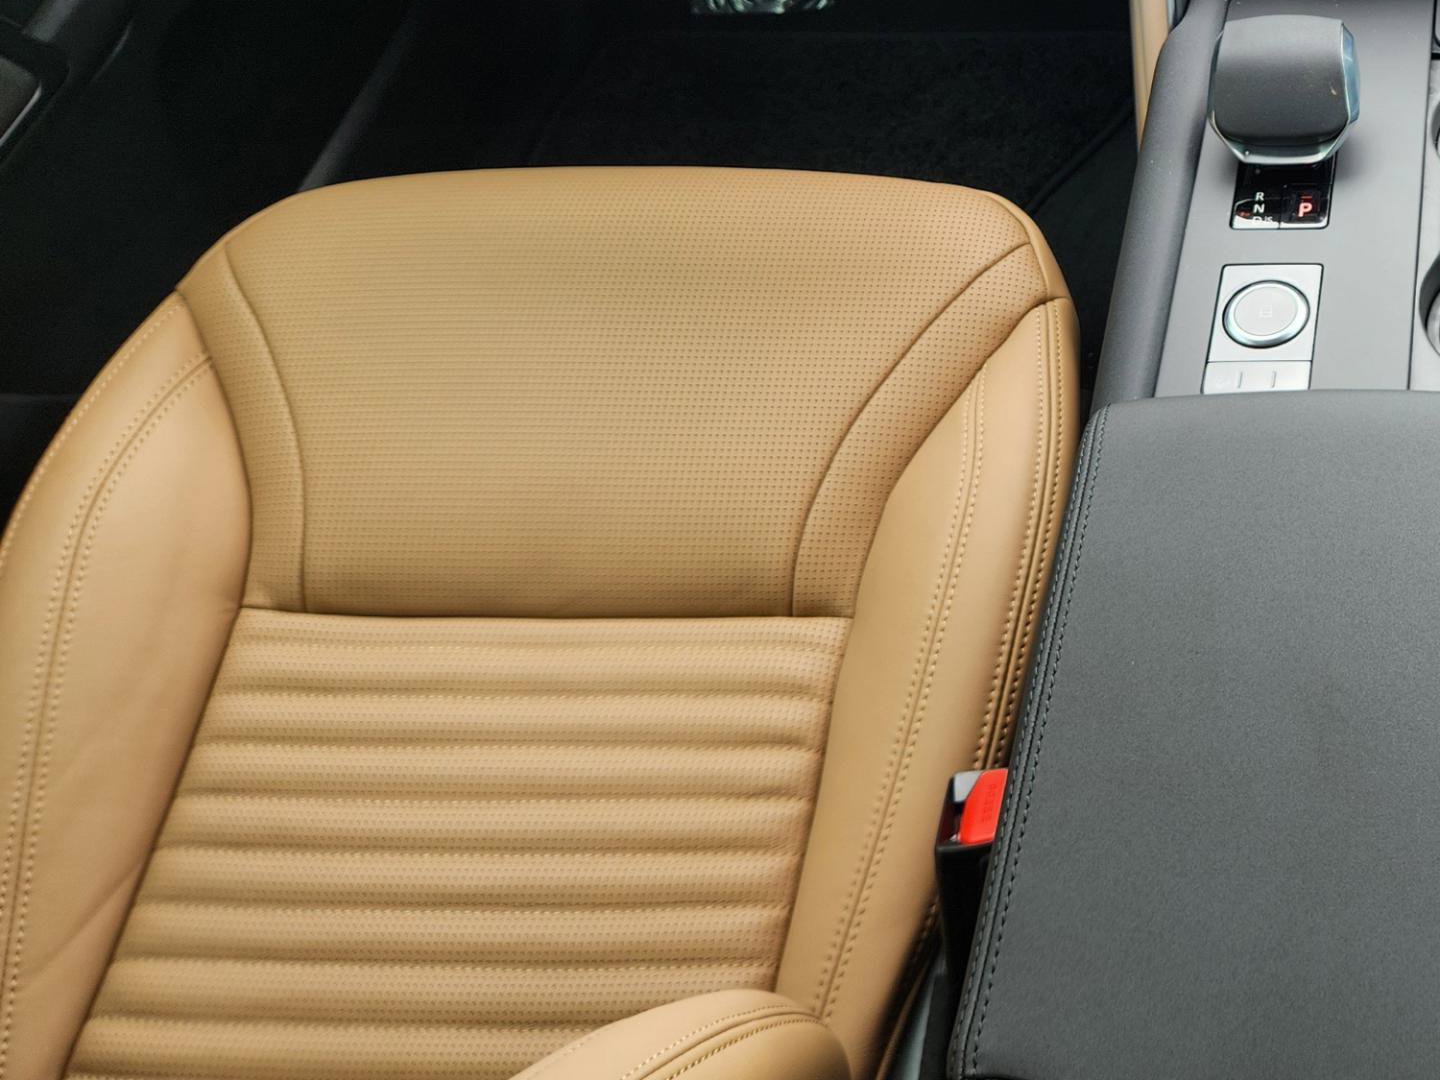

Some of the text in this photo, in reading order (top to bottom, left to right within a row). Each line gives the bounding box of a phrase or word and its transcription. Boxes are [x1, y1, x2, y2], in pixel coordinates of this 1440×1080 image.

[1255, 191, 1265, 201] R
[1253, 203, 1265, 213] N
[1298, 202, 1313, 217] P
